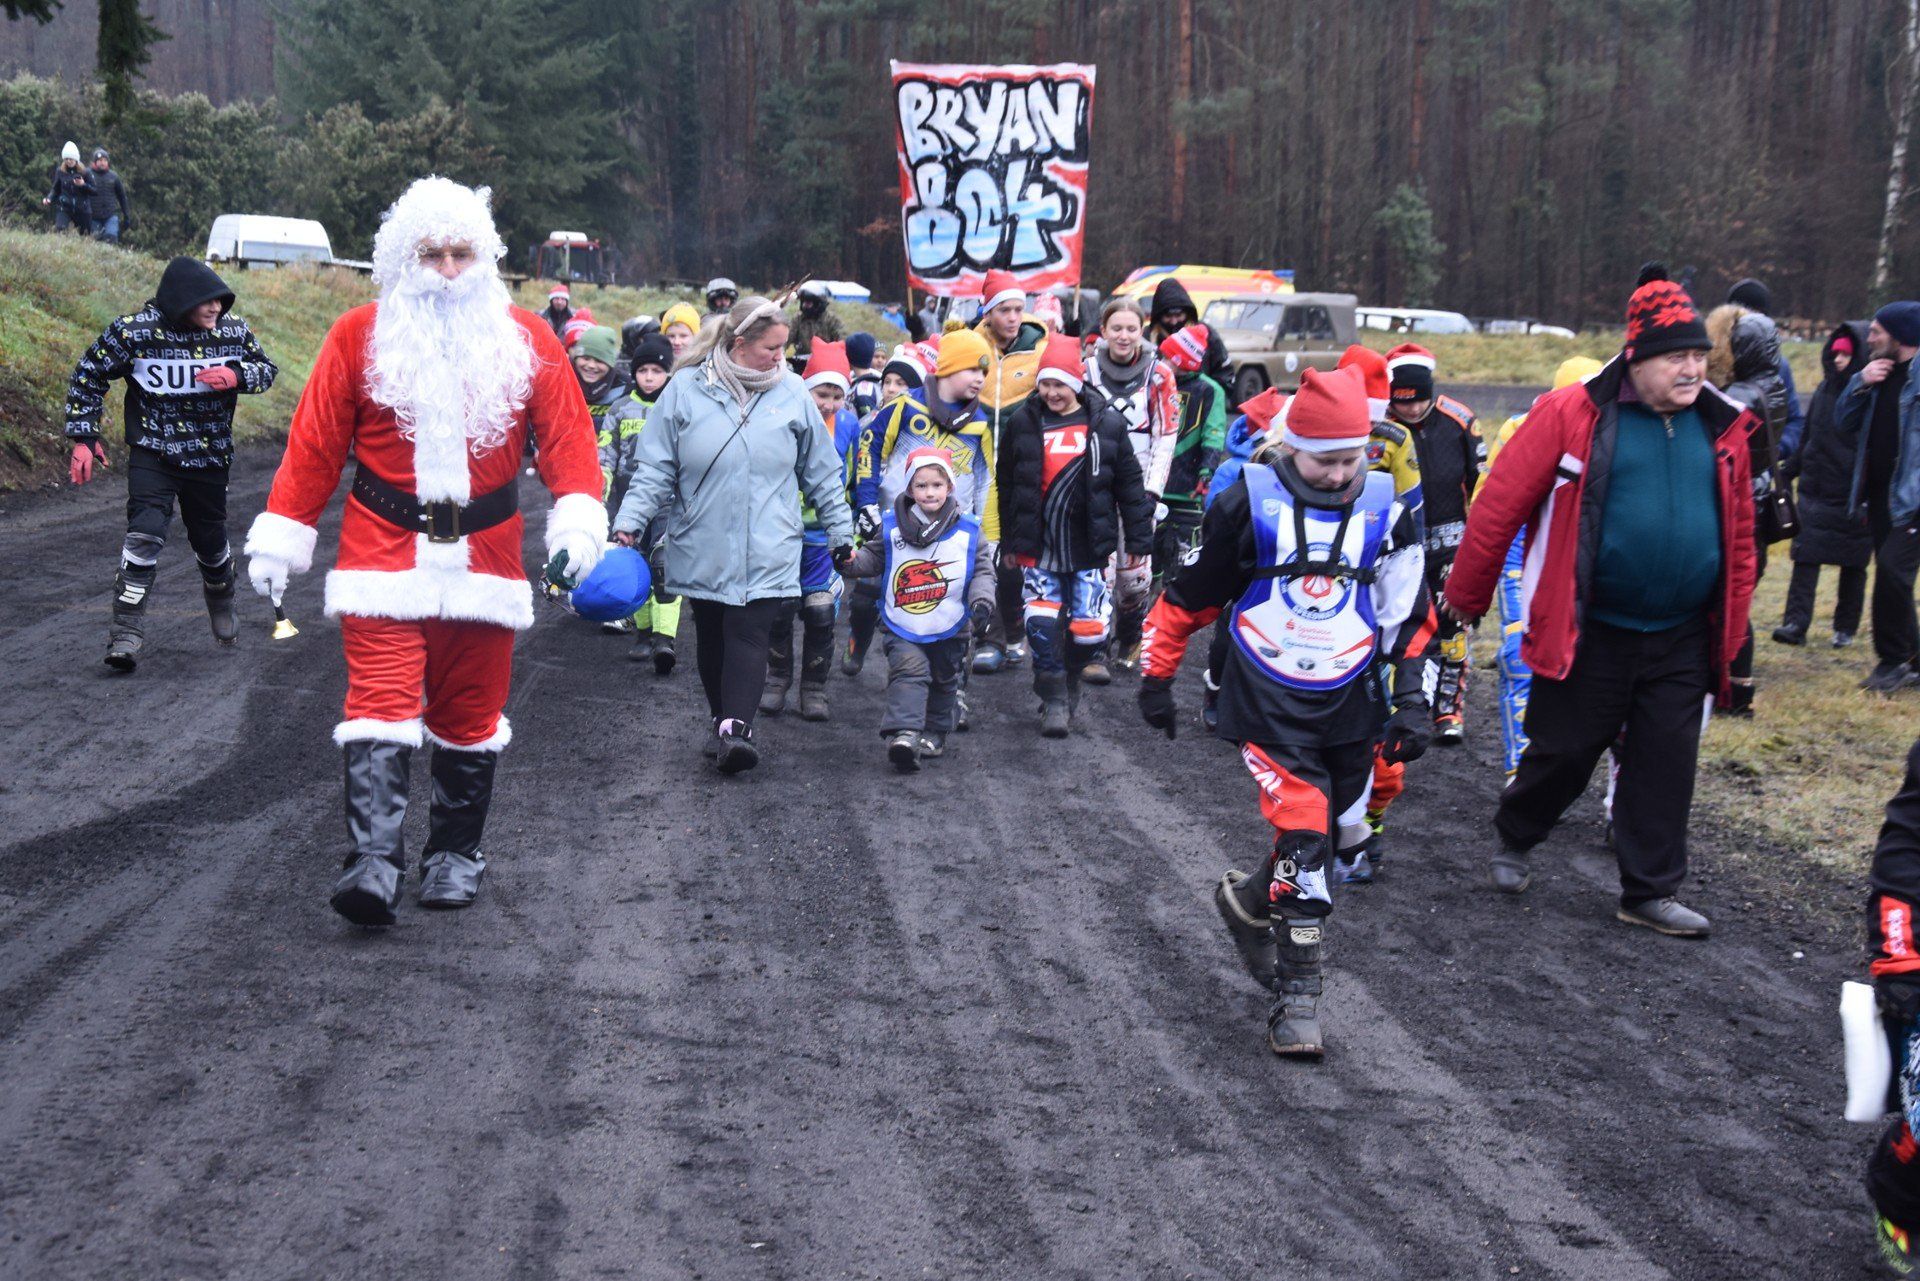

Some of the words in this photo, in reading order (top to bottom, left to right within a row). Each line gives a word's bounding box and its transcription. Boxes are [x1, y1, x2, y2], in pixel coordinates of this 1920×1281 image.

[899, 80, 1080, 164] BRYAN
[146, 348, 191, 359] SUPER
[205, 345, 243, 357] SUPER
[147, 363, 221, 389] SUP
[166, 438, 202, 455] SUPER
